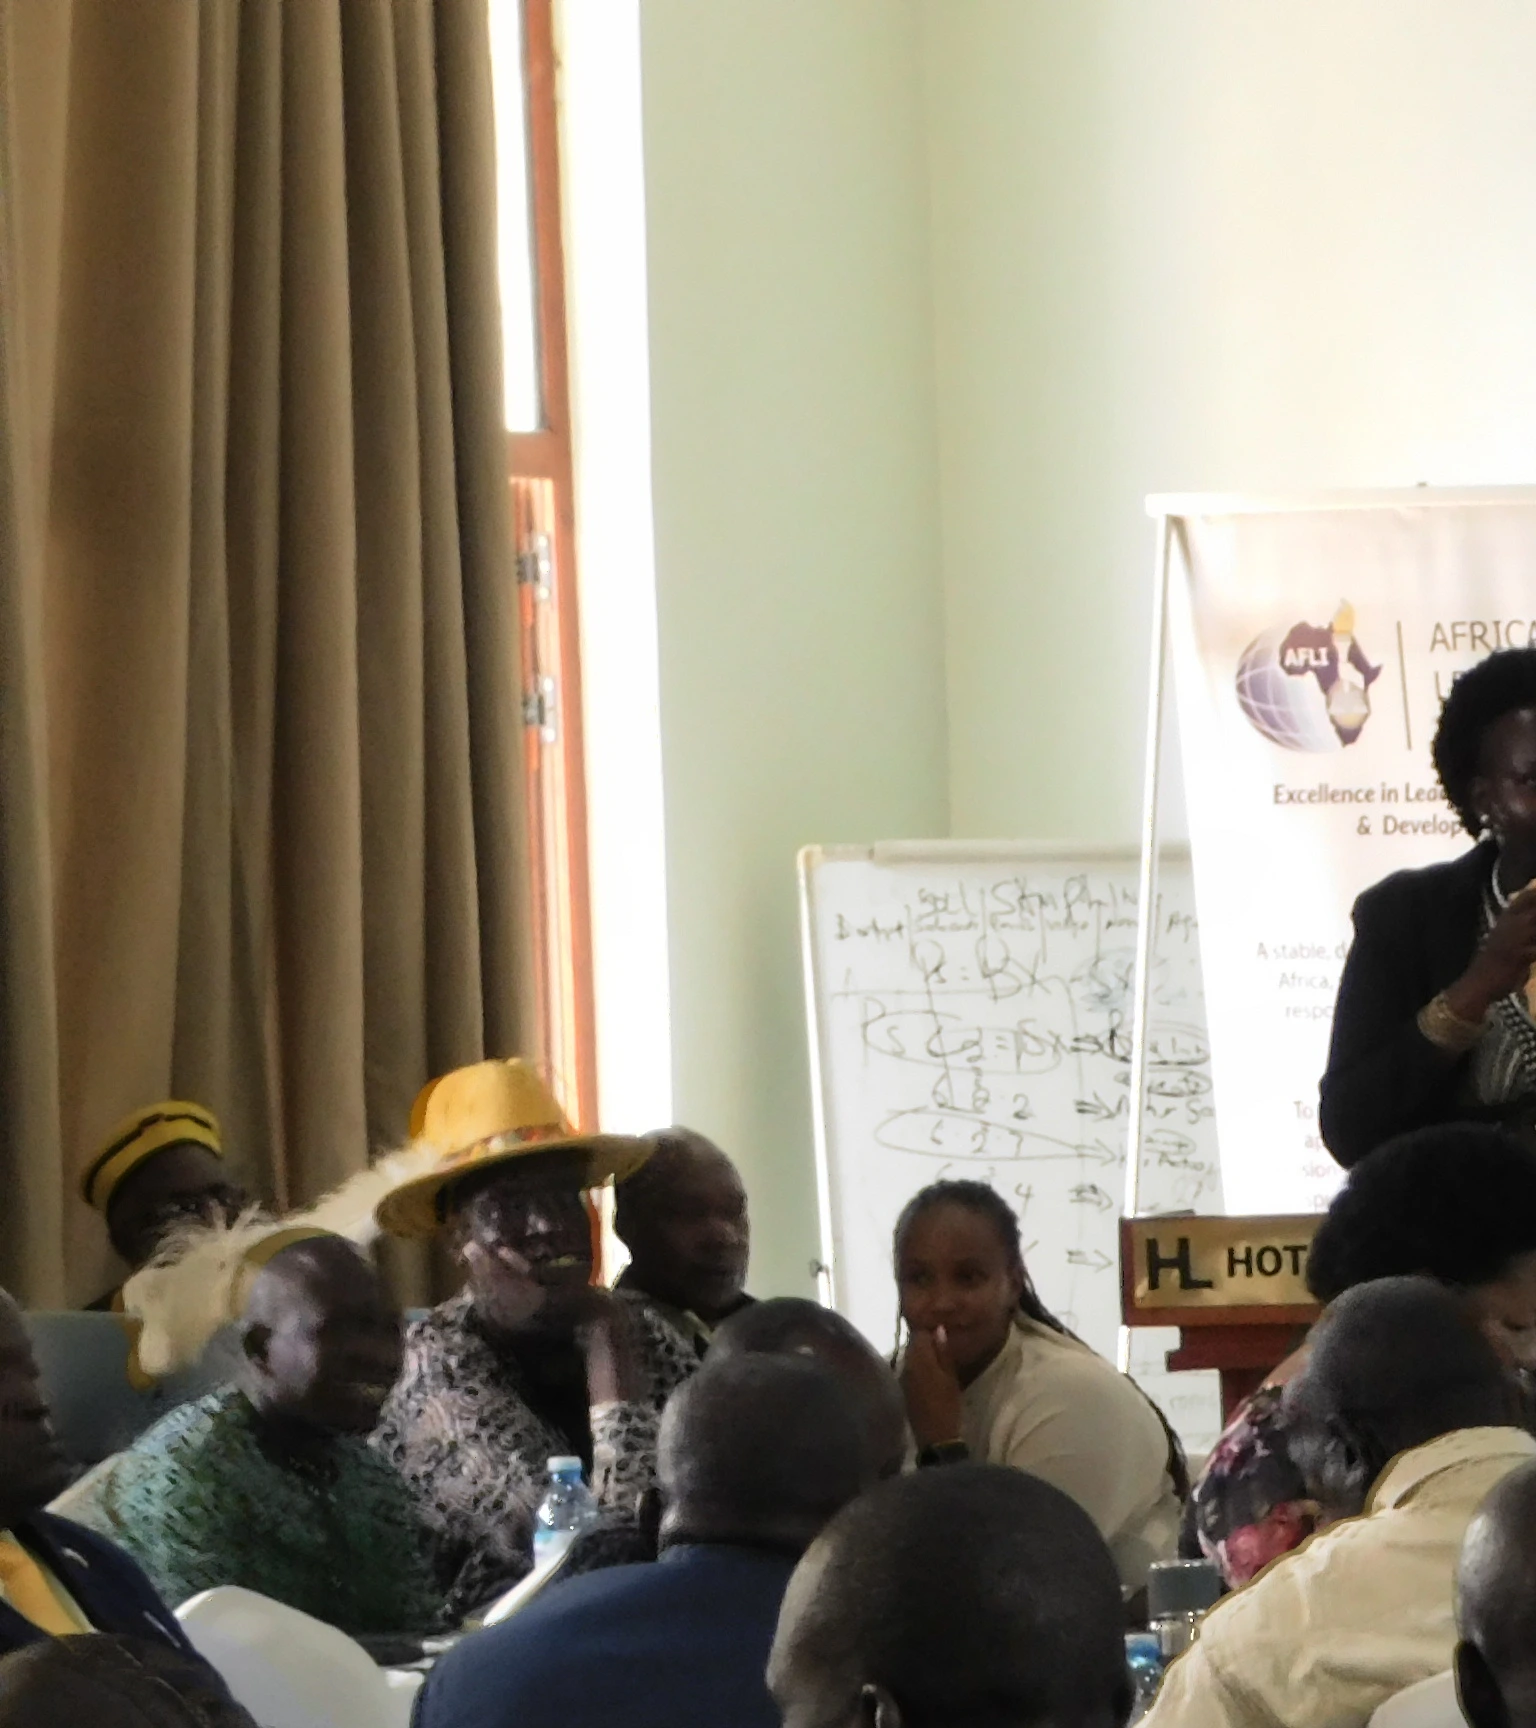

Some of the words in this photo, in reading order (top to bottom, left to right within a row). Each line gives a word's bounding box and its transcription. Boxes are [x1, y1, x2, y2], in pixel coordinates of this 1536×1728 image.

[1284, 646, 1328, 668] AFLI
[1273, 783, 1376, 806] Excellence
[1380, 782, 1399, 802] in
[1357, 815, 1372, 836] &
[1382, 813, 1464, 839] Develop
[1256, 942, 1268, 960] A
[1226, 1244, 1308, 1278] HOT
